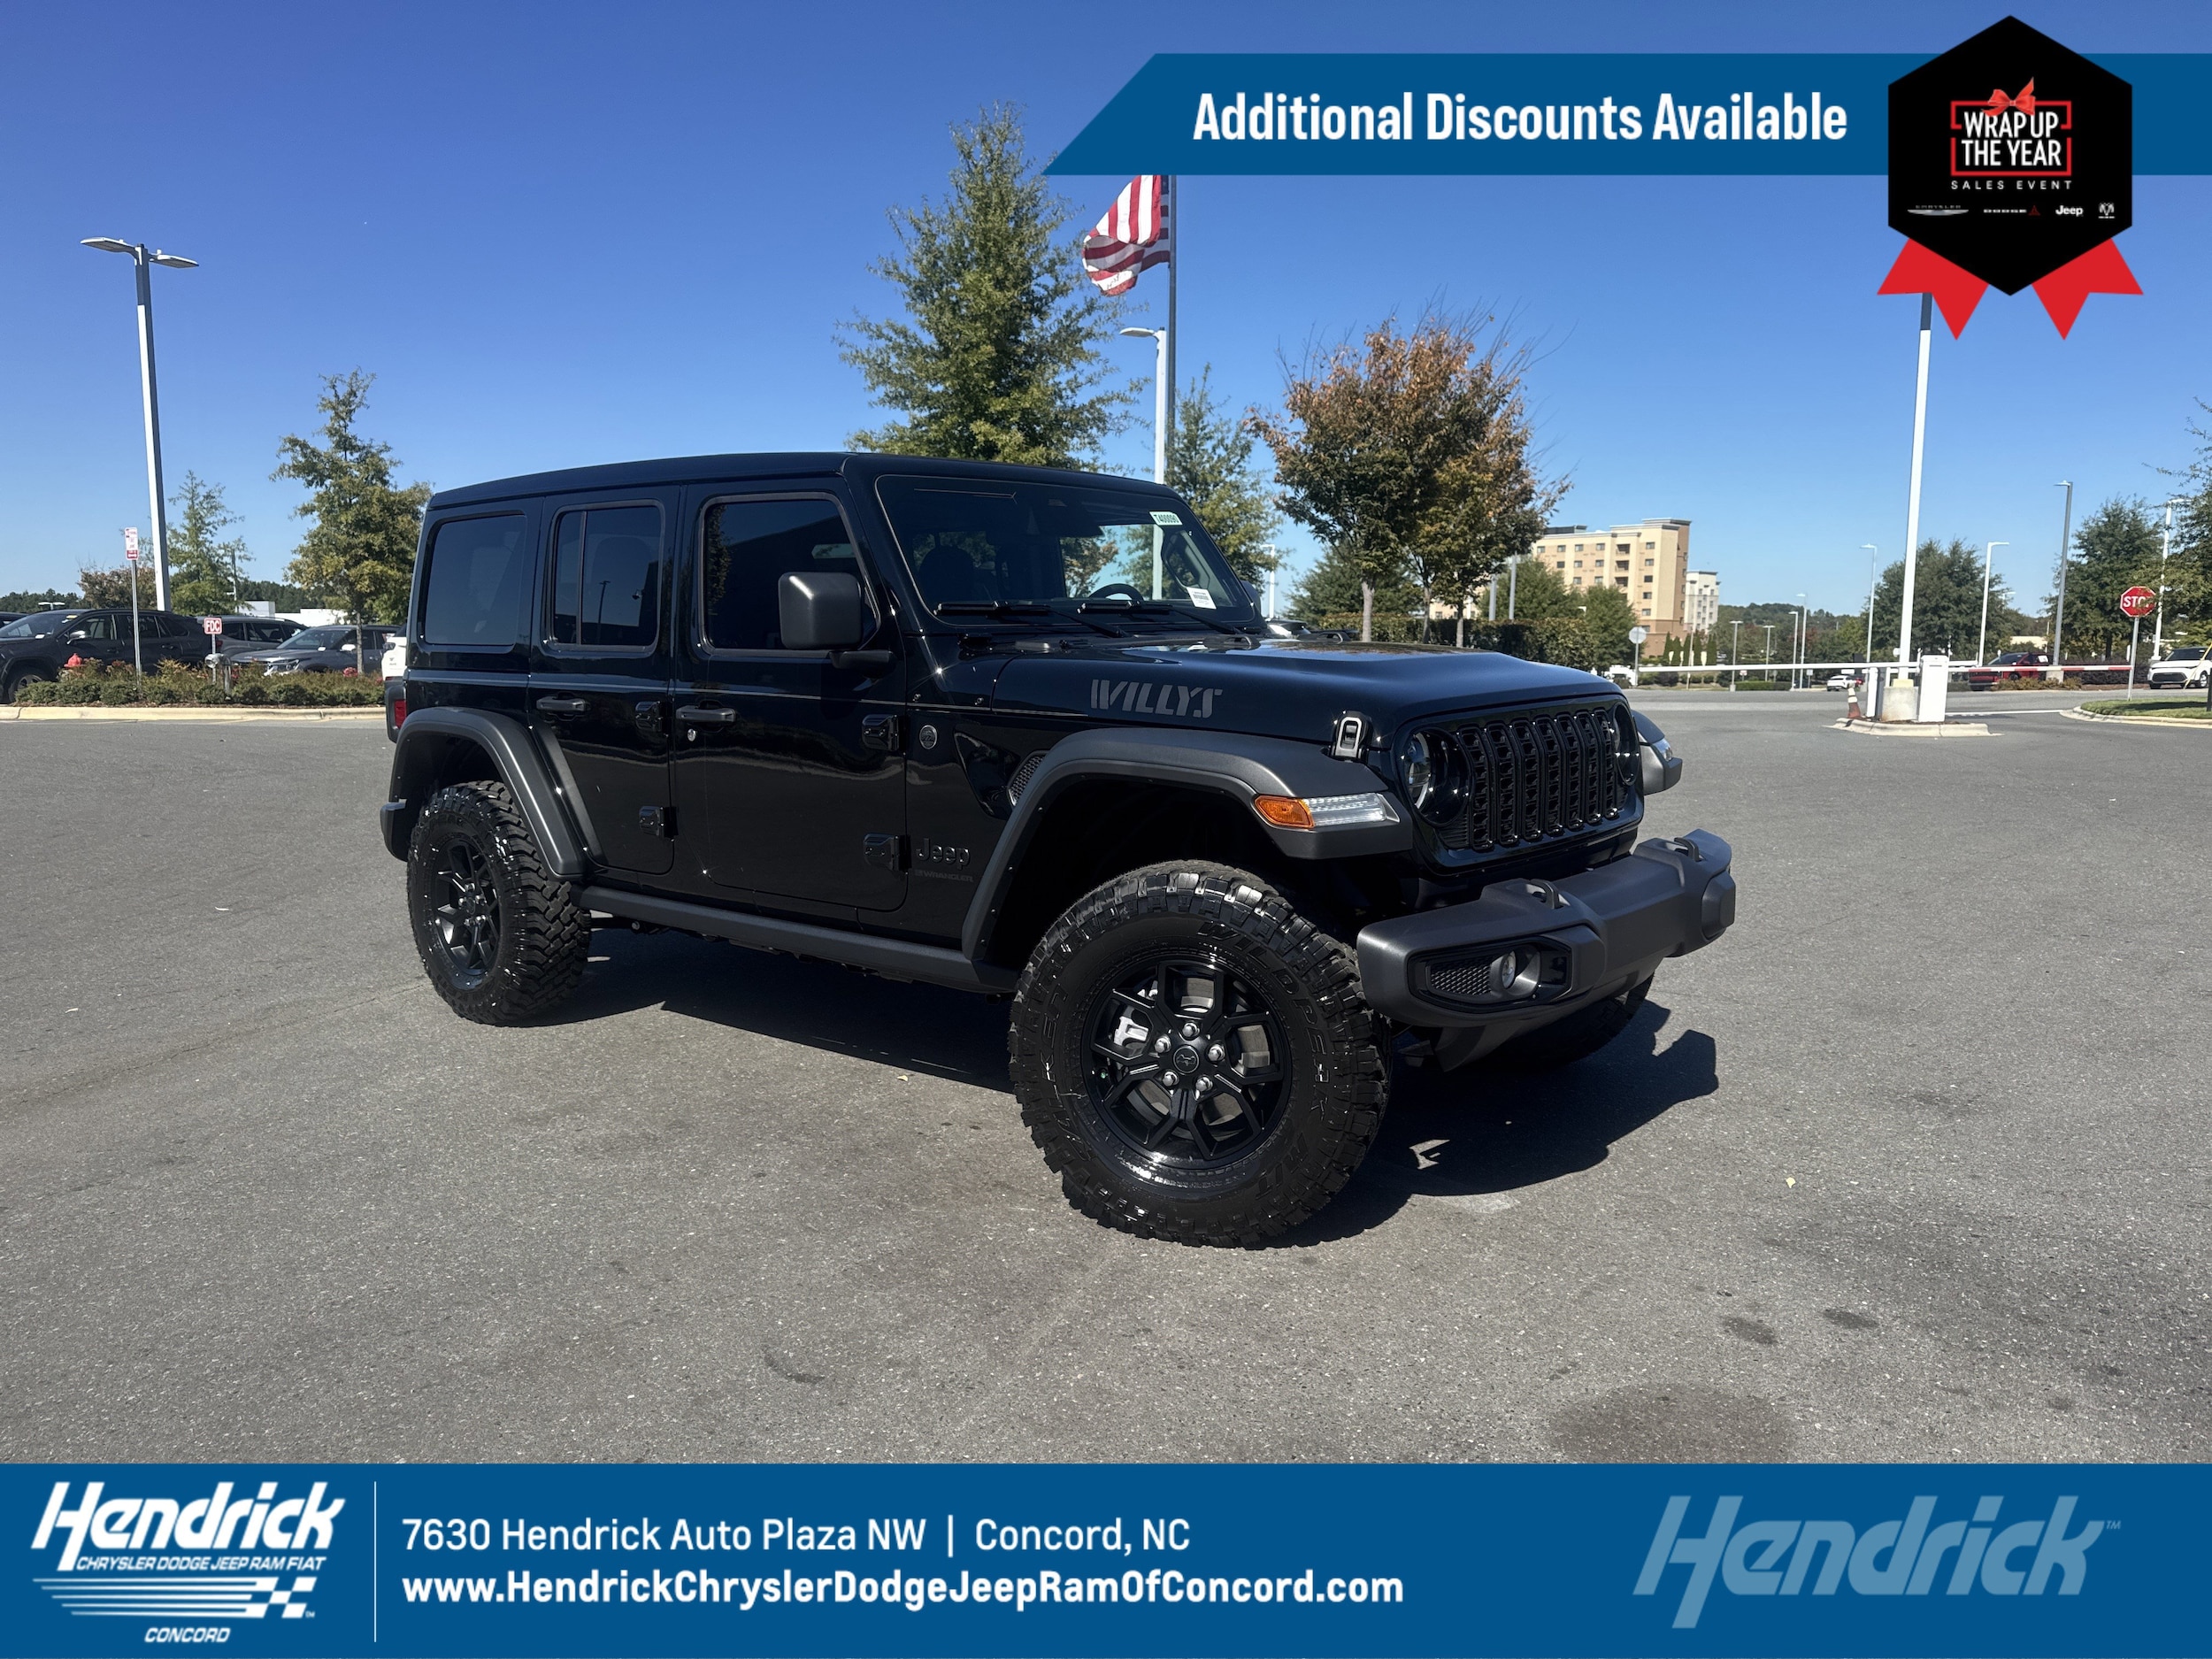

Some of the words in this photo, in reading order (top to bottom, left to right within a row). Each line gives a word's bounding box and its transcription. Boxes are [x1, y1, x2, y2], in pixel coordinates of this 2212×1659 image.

[205, 619, 220, 632] FDC
[1090, 679, 1223, 718] WILLYS
[916, 837, 970, 871] Jeep
[924, 870, 974, 883] WRANGLER
